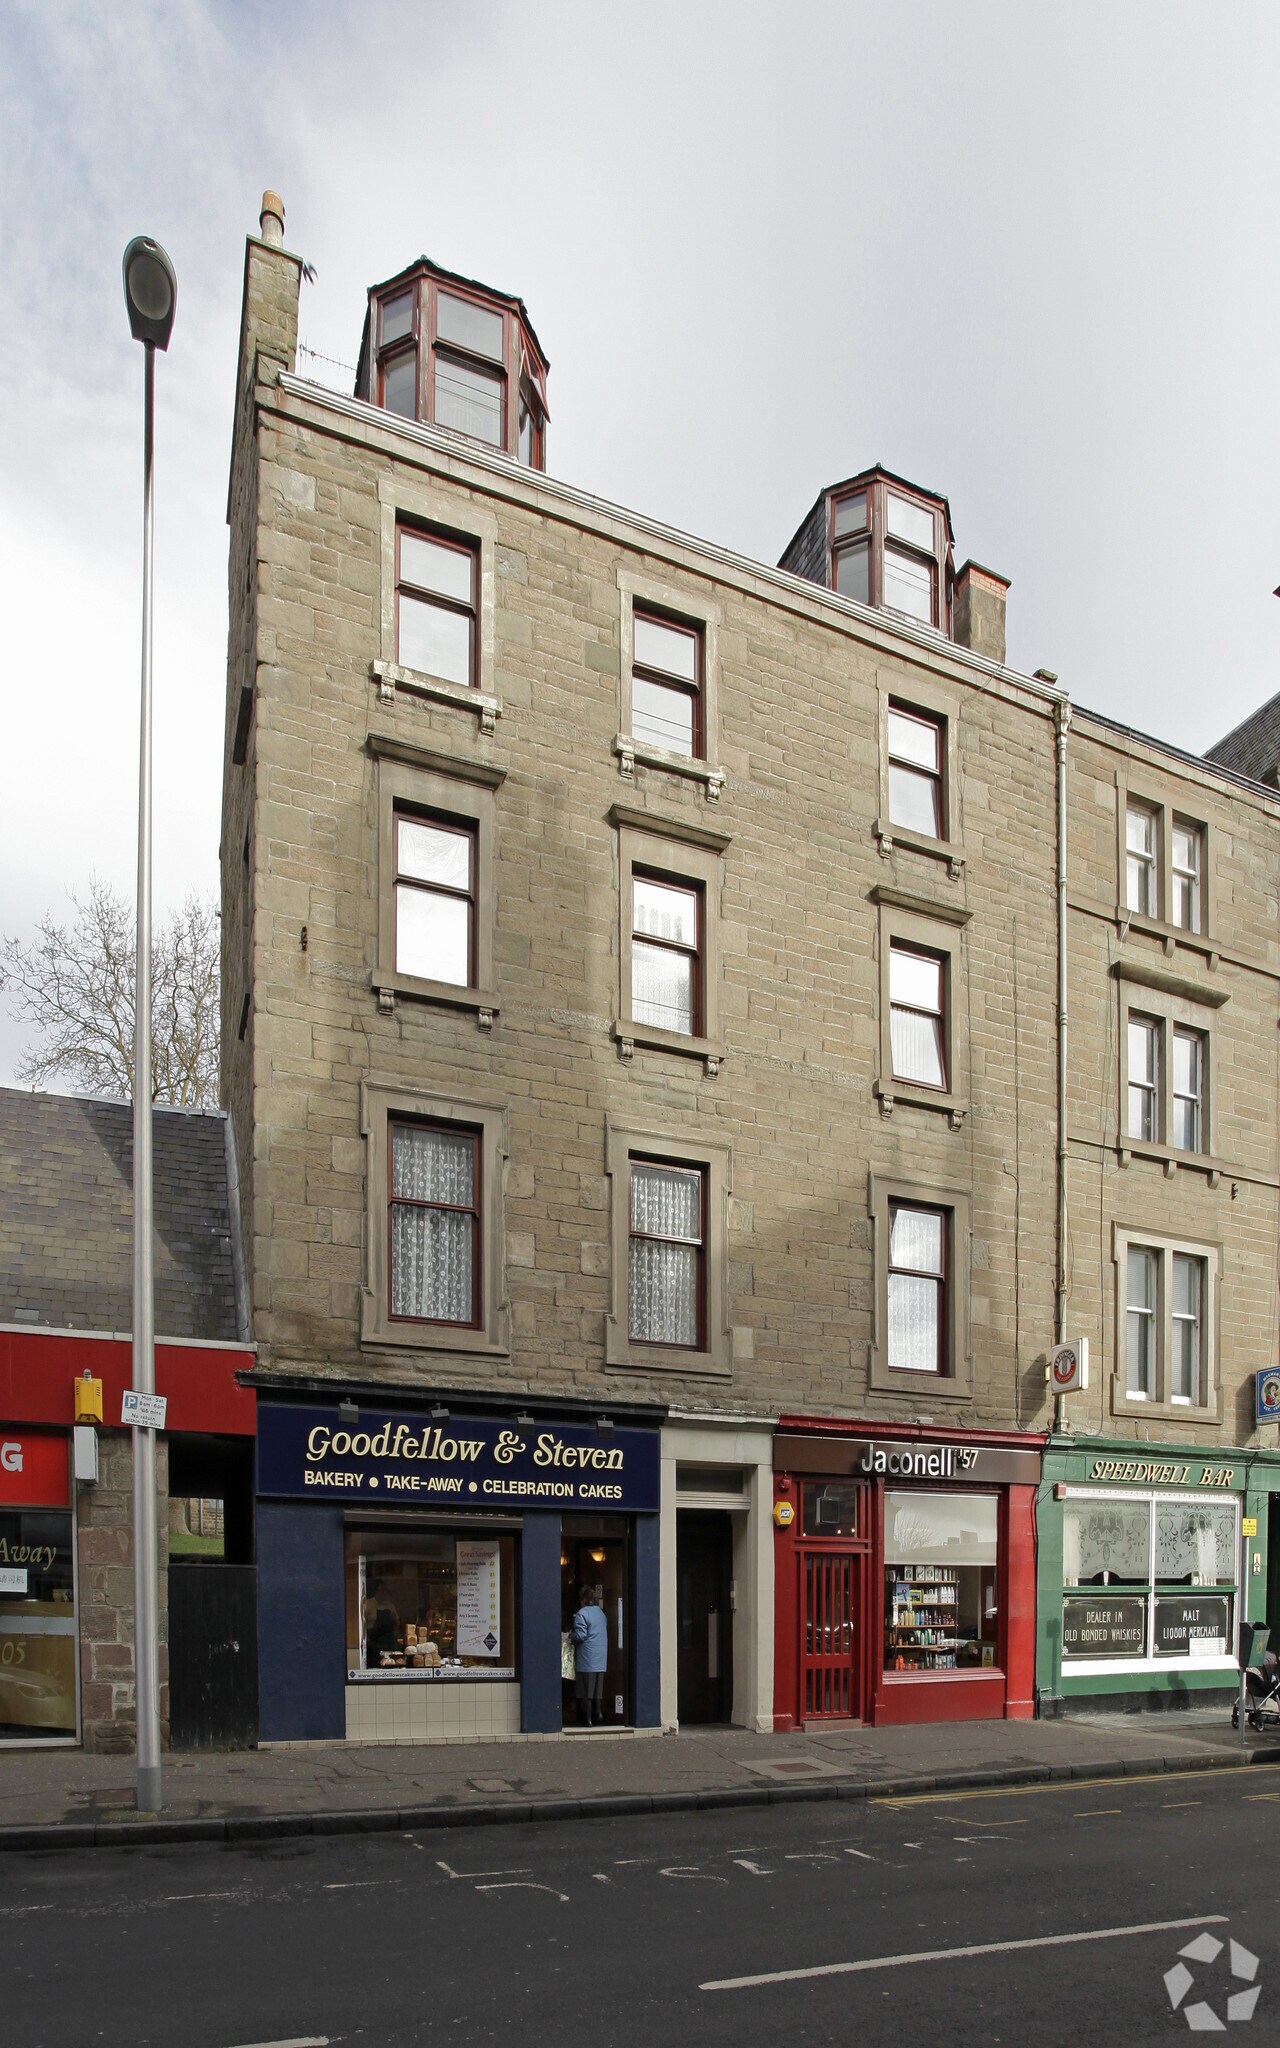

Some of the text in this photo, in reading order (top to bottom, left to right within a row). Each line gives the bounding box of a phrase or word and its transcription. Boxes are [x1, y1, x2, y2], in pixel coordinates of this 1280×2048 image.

[127, 1396, 136, 1408] P
[306, 1421, 624, 1470] Goodfellow & Steven
[1, 1442, 24, 1473] G
[1090, 1460, 1234, 1487] SPEEDWELL BAR
[304, 1470, 623, 1499] BAKERY TAKE-AWAY CELEBRATION CAKES
[1086, 1611, 1123, 1624] DEALER IN
[1182, 1609, 1200, 1622] MALT
[1064, 1629, 1141, 1641] OLD BONDED WHISKIES
[1163, 1625, 1219, 1640] LIQUOR MERCHANT
